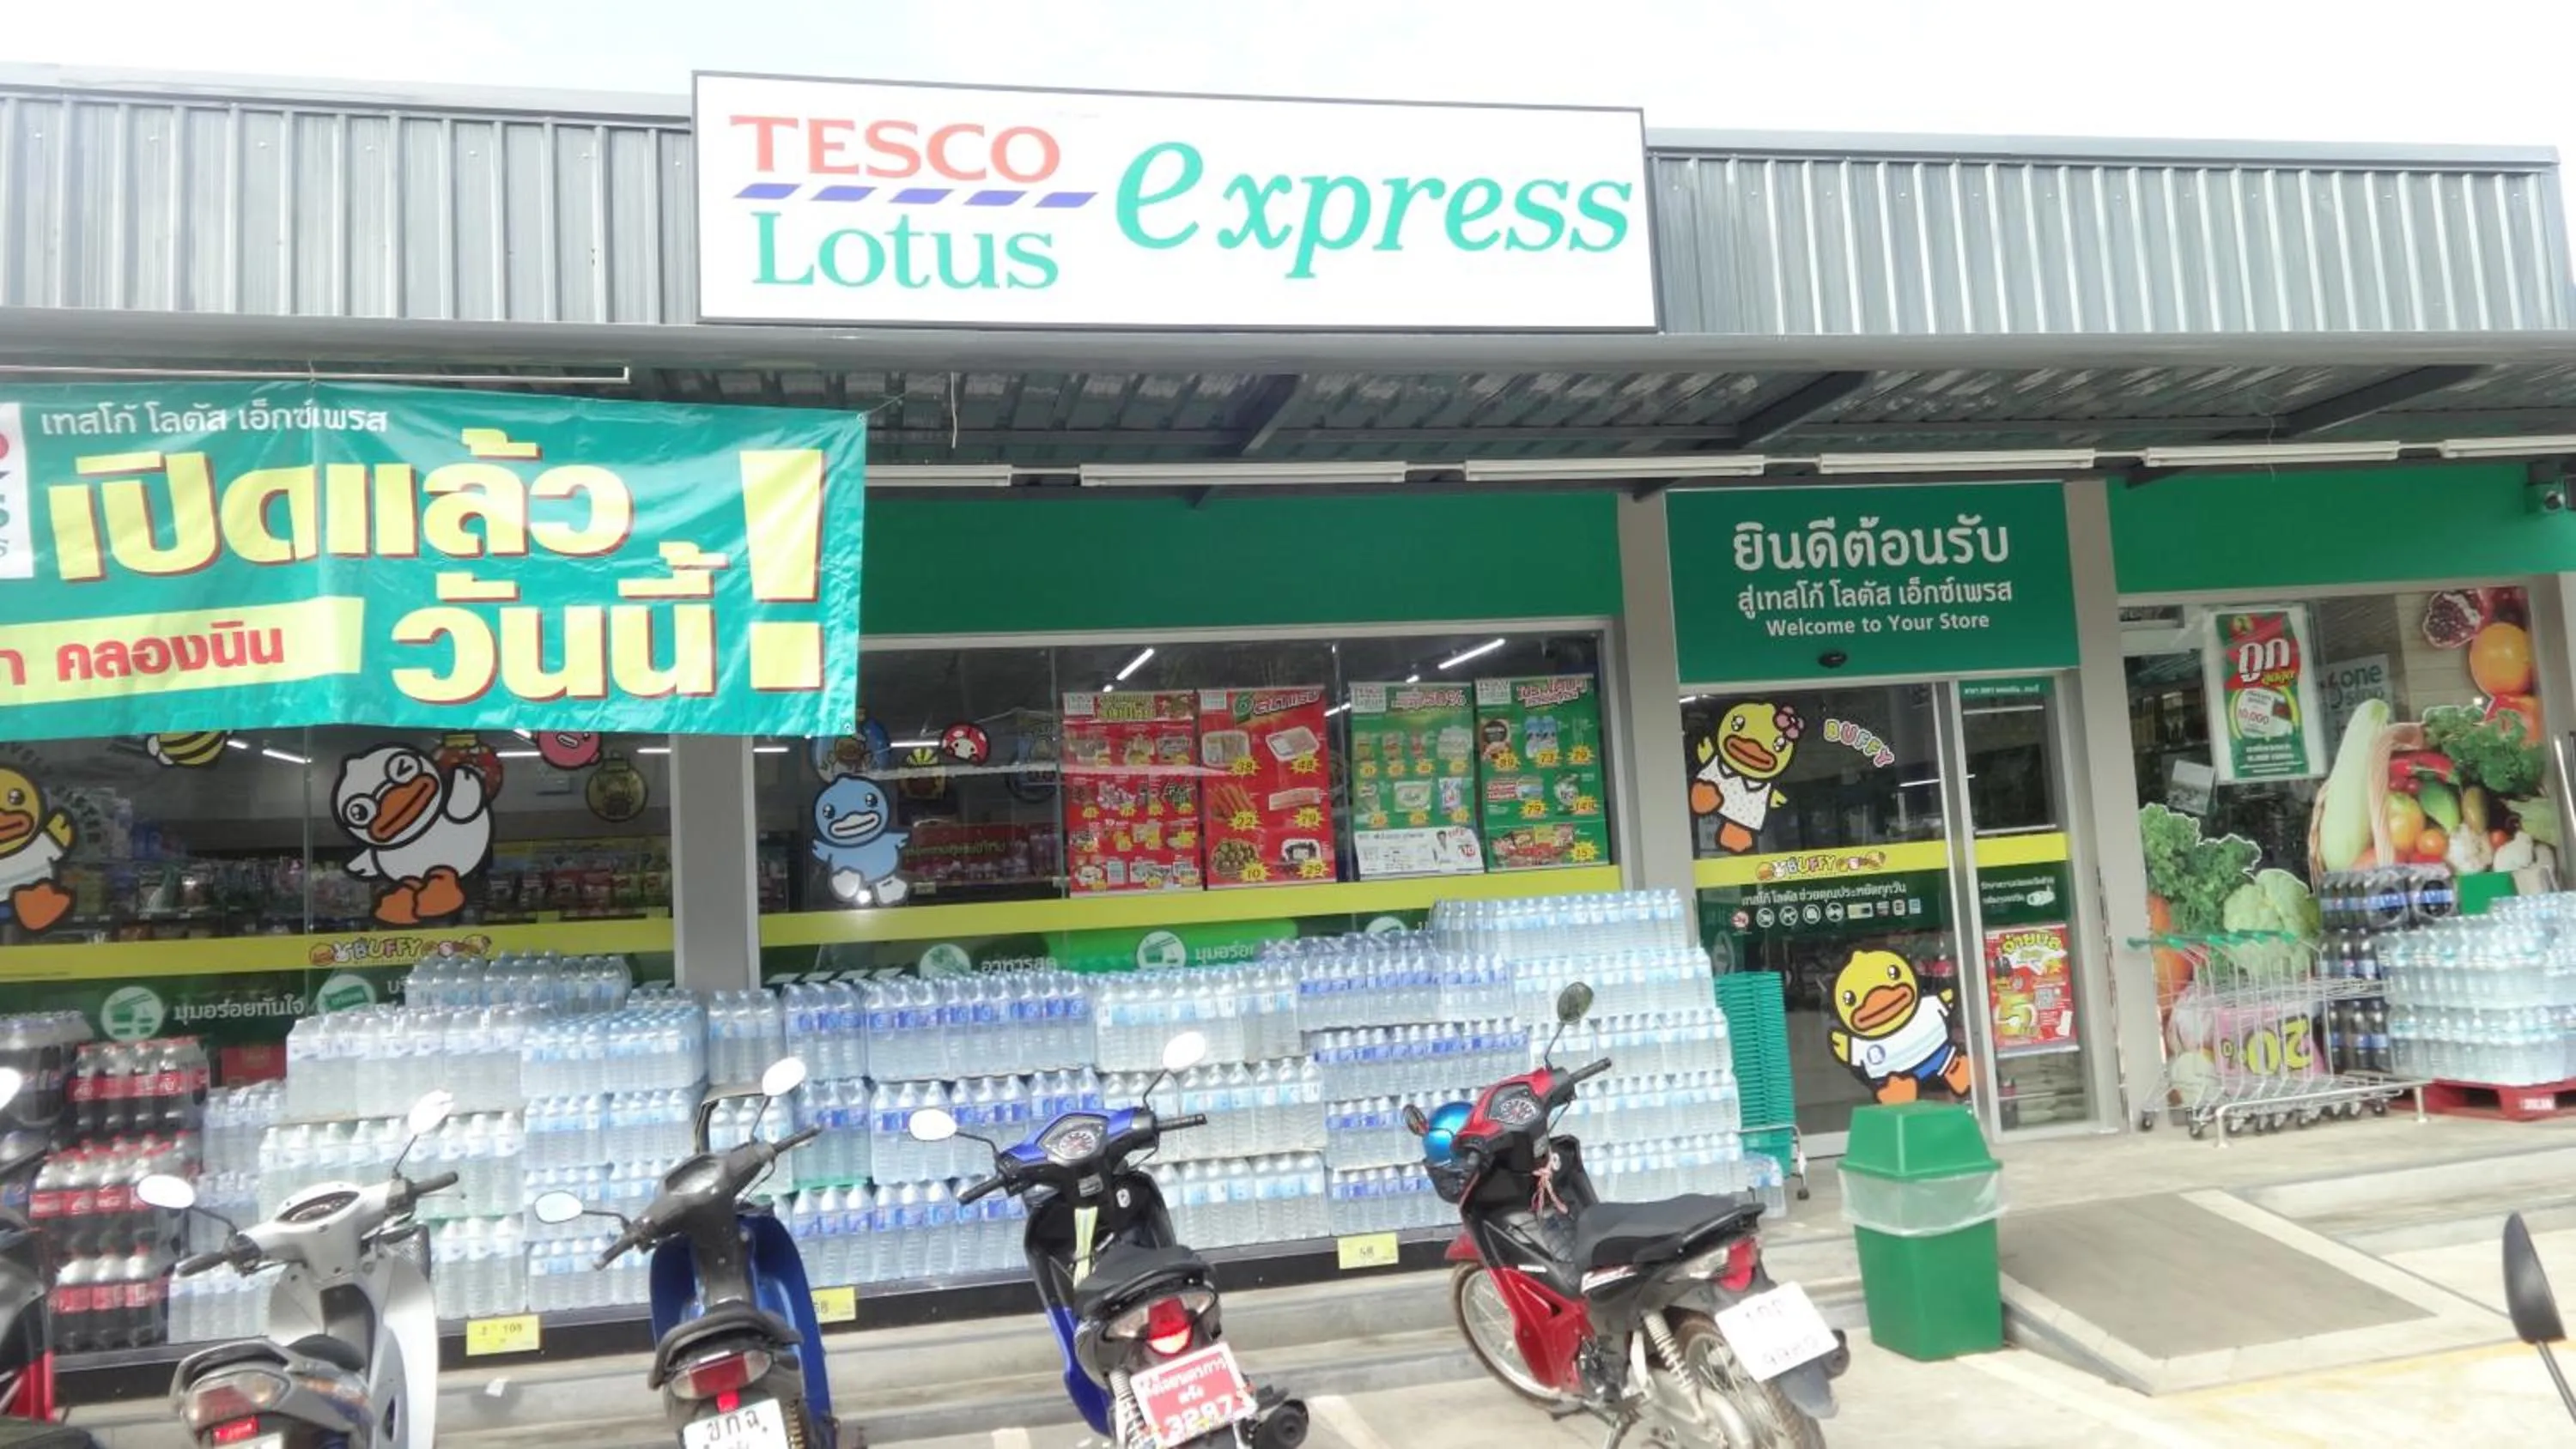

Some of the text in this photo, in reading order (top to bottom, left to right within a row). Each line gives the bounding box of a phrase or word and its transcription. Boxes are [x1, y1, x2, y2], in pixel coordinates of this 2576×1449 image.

[729, 113, 1061, 184] TESCO
[1115, 140, 1633, 279] express
[751, 210, 1060, 291] Lotus
[41, 398, 390, 436] เทสโก้ โลตัส เอ็กซ์เพรส
[48, 427, 635, 584] เปิดแล้ว
[1733, 514, 2009, 572] ยินดีต้อนรับ
[391, 541, 728, 705] วันนี้
[1737, 576, 2013, 620] สู่เทสโก้ โลตัส เอ็กซ์เพรส
[1766, 612, 1990, 638] Welcome to Your Store
[57, 621, 284, 682] คลองนิน
[1824, 718, 1896, 768] BUFFY
[352, 936, 422, 960] BUFFY
[173, 994, 306, 1024] มุมอร่อยทันใจ
